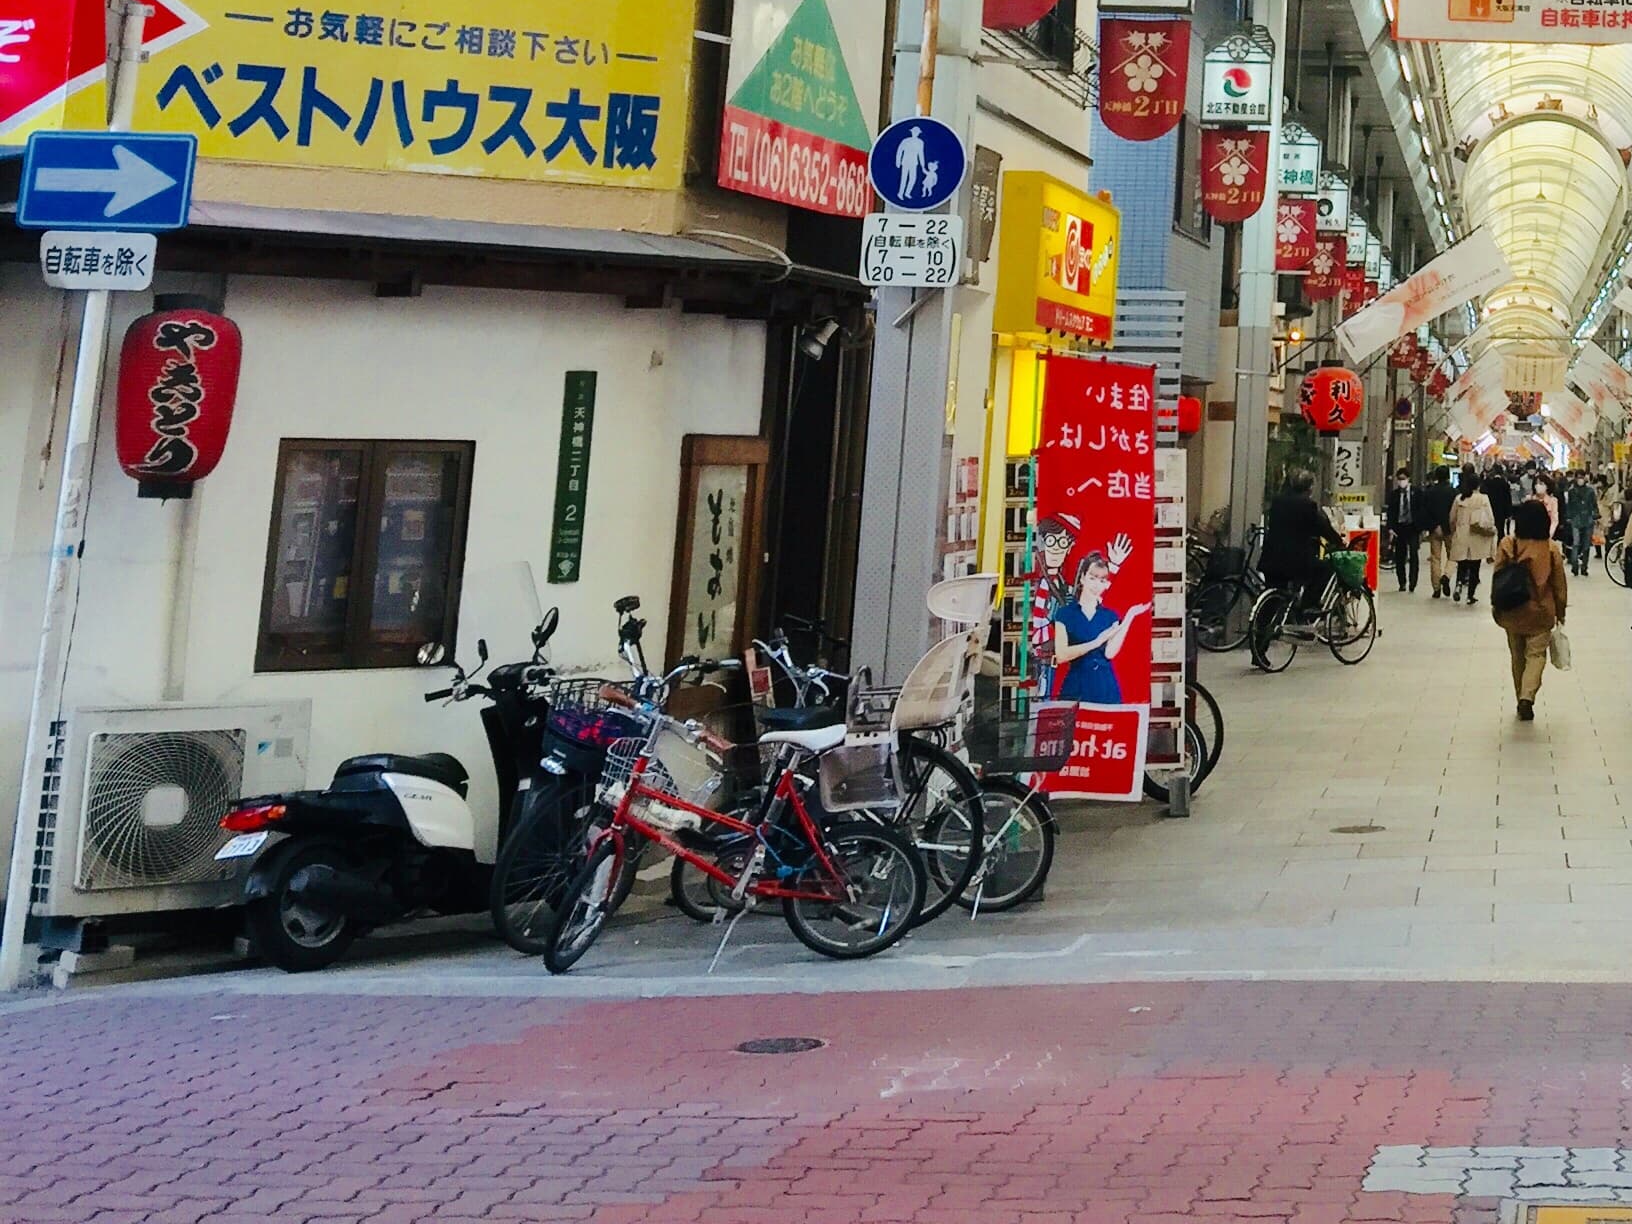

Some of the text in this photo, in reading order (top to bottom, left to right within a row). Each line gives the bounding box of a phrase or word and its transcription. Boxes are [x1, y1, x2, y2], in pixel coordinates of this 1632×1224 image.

[155, 64, 661, 171] ベストハウス大阪
[878, 218, 889, 232] 7
[925, 219, 948, 235] 22
[874, 235, 950, 249] 自転車を除く
[46, 245, 147, 278] 自転車を除く
[878, 251, 888, 264] 7
[927, 251, 943, 265] 10
[872, 267, 893, 282] 20
[925, 268, 947, 283] 22
[127, 321, 217, 474] やきとり
[1330, 380, 1350, 423] 利久
[567, 407, 585, 491] 天神橋二丁目
[565, 504, 577, 521] 2
